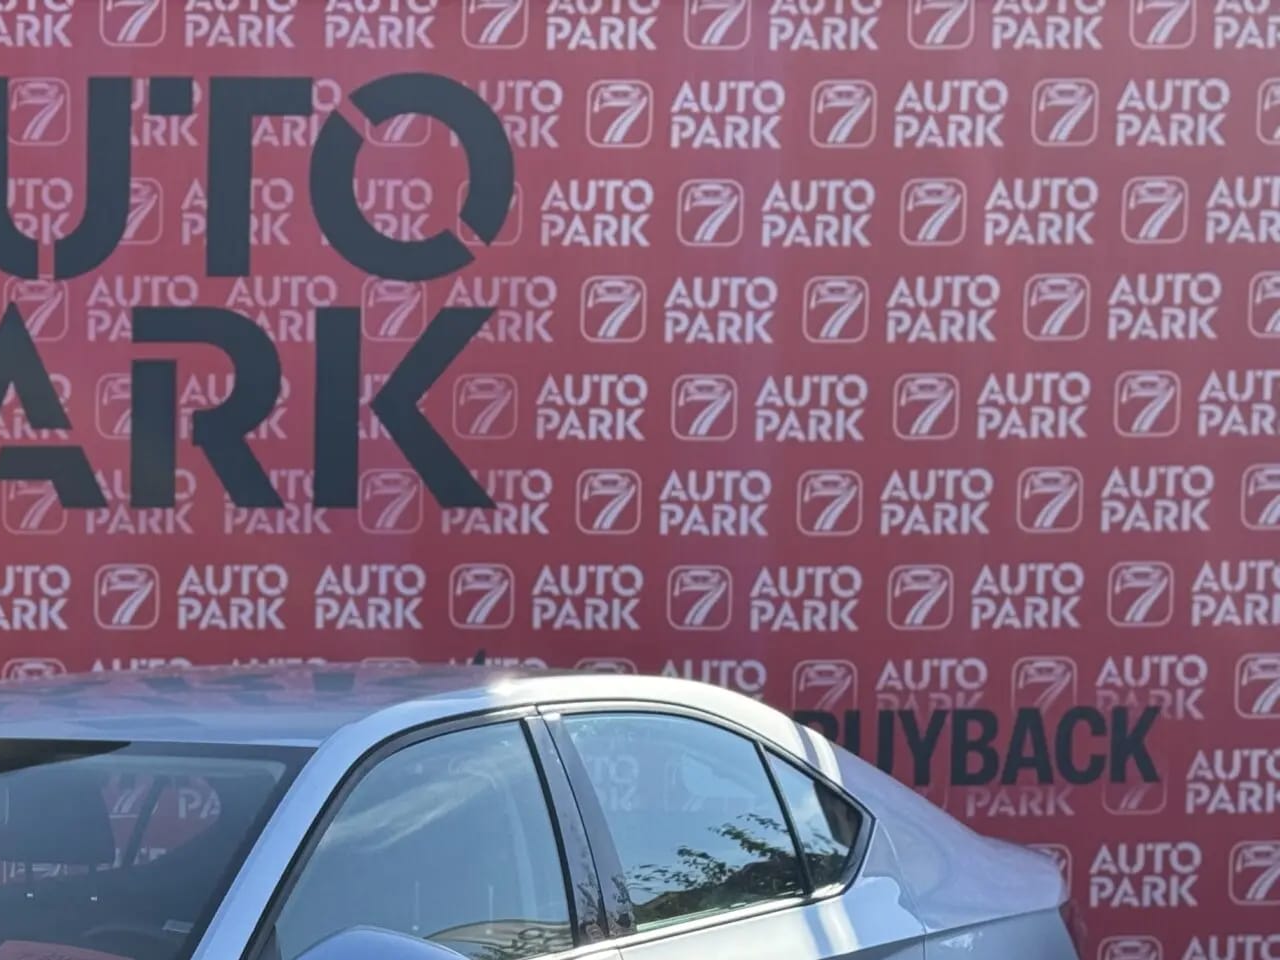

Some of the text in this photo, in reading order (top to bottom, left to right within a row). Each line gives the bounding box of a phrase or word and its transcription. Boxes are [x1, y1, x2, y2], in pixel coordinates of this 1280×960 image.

[186, 14, 293, 47] PARK
[326, 15, 434, 48] PARK
[547, 17, 656, 50] PARK
[770, 17, 878, 50] PARK
[993, 16, 1102, 49] PARK
[671, 81, 785, 114] AUTO
[895, 80, 1008, 113] AUTO
[1117, 79, 1230, 112] AUTO
[671, 116, 780, 148] PARK
[895, 115, 1003, 147] PARK
[1117, 114, 1225, 146] PARK
[542, 180, 653, 213] AUTO
[762, 180, 875, 213] AUTO
[985, 178, 1098, 211] AUTO
[542, 214, 649, 246] PARK
[762, 214, 870, 246] PARK
[985, 212, 1094, 245] PARK
[87, 276, 199, 308] AUTO
[225, 276, 337, 308] AUTO
[444, 276, 557, 309] AUTO
[665, 277, 777, 310] AUTO
[887, 275, 1000, 308] AUTO
[1109, 273, 1221, 306] AUTO
[665, 311, 773, 343] PARK
[887, 310, 995, 342] PARK
[1108, 307, 1216, 339] PARK
[537, 375, 647, 407] AUTO
[756, 375, 867, 408] AUTO
[978, 372, 1090, 405] AUTO
[537, 408, 644, 440] PARK
[756, 409, 863, 441] PARK
[978, 406, 1086, 438] PARK
[660, 471, 771, 505] AUTO
[881, 469, 993, 502] AUTO
[1102, 466, 1213, 499] AUTO
[86, 502, 192, 534] PARK
[225, 502, 331, 534] PARK
[442, 502, 549, 534] PARK
[660, 504, 767, 535] PARK
[881, 502, 988, 534] PARK
[1101, 499, 1209, 531] PARK
[178, 565, 288, 597] AUTO
[315, 564, 425, 596] AUTO
[533, 565, 643, 597] AUTO
[751, 566, 862, 598] AUTO
[972, 563, 1084, 596] AUTO
[178, 598, 284, 629] PARK
[316, 598, 421, 629] PARK
[533, 598, 639, 629] PARK
[751, 600, 857, 631] PARK
[972, 596, 1080, 629] PARK
[876, 658, 987, 691] AUTO
[1096, 655, 1207, 687] AUTO
[1090, 842, 1201, 875] AUTO
[1090, 875, 1197, 906] PARK
